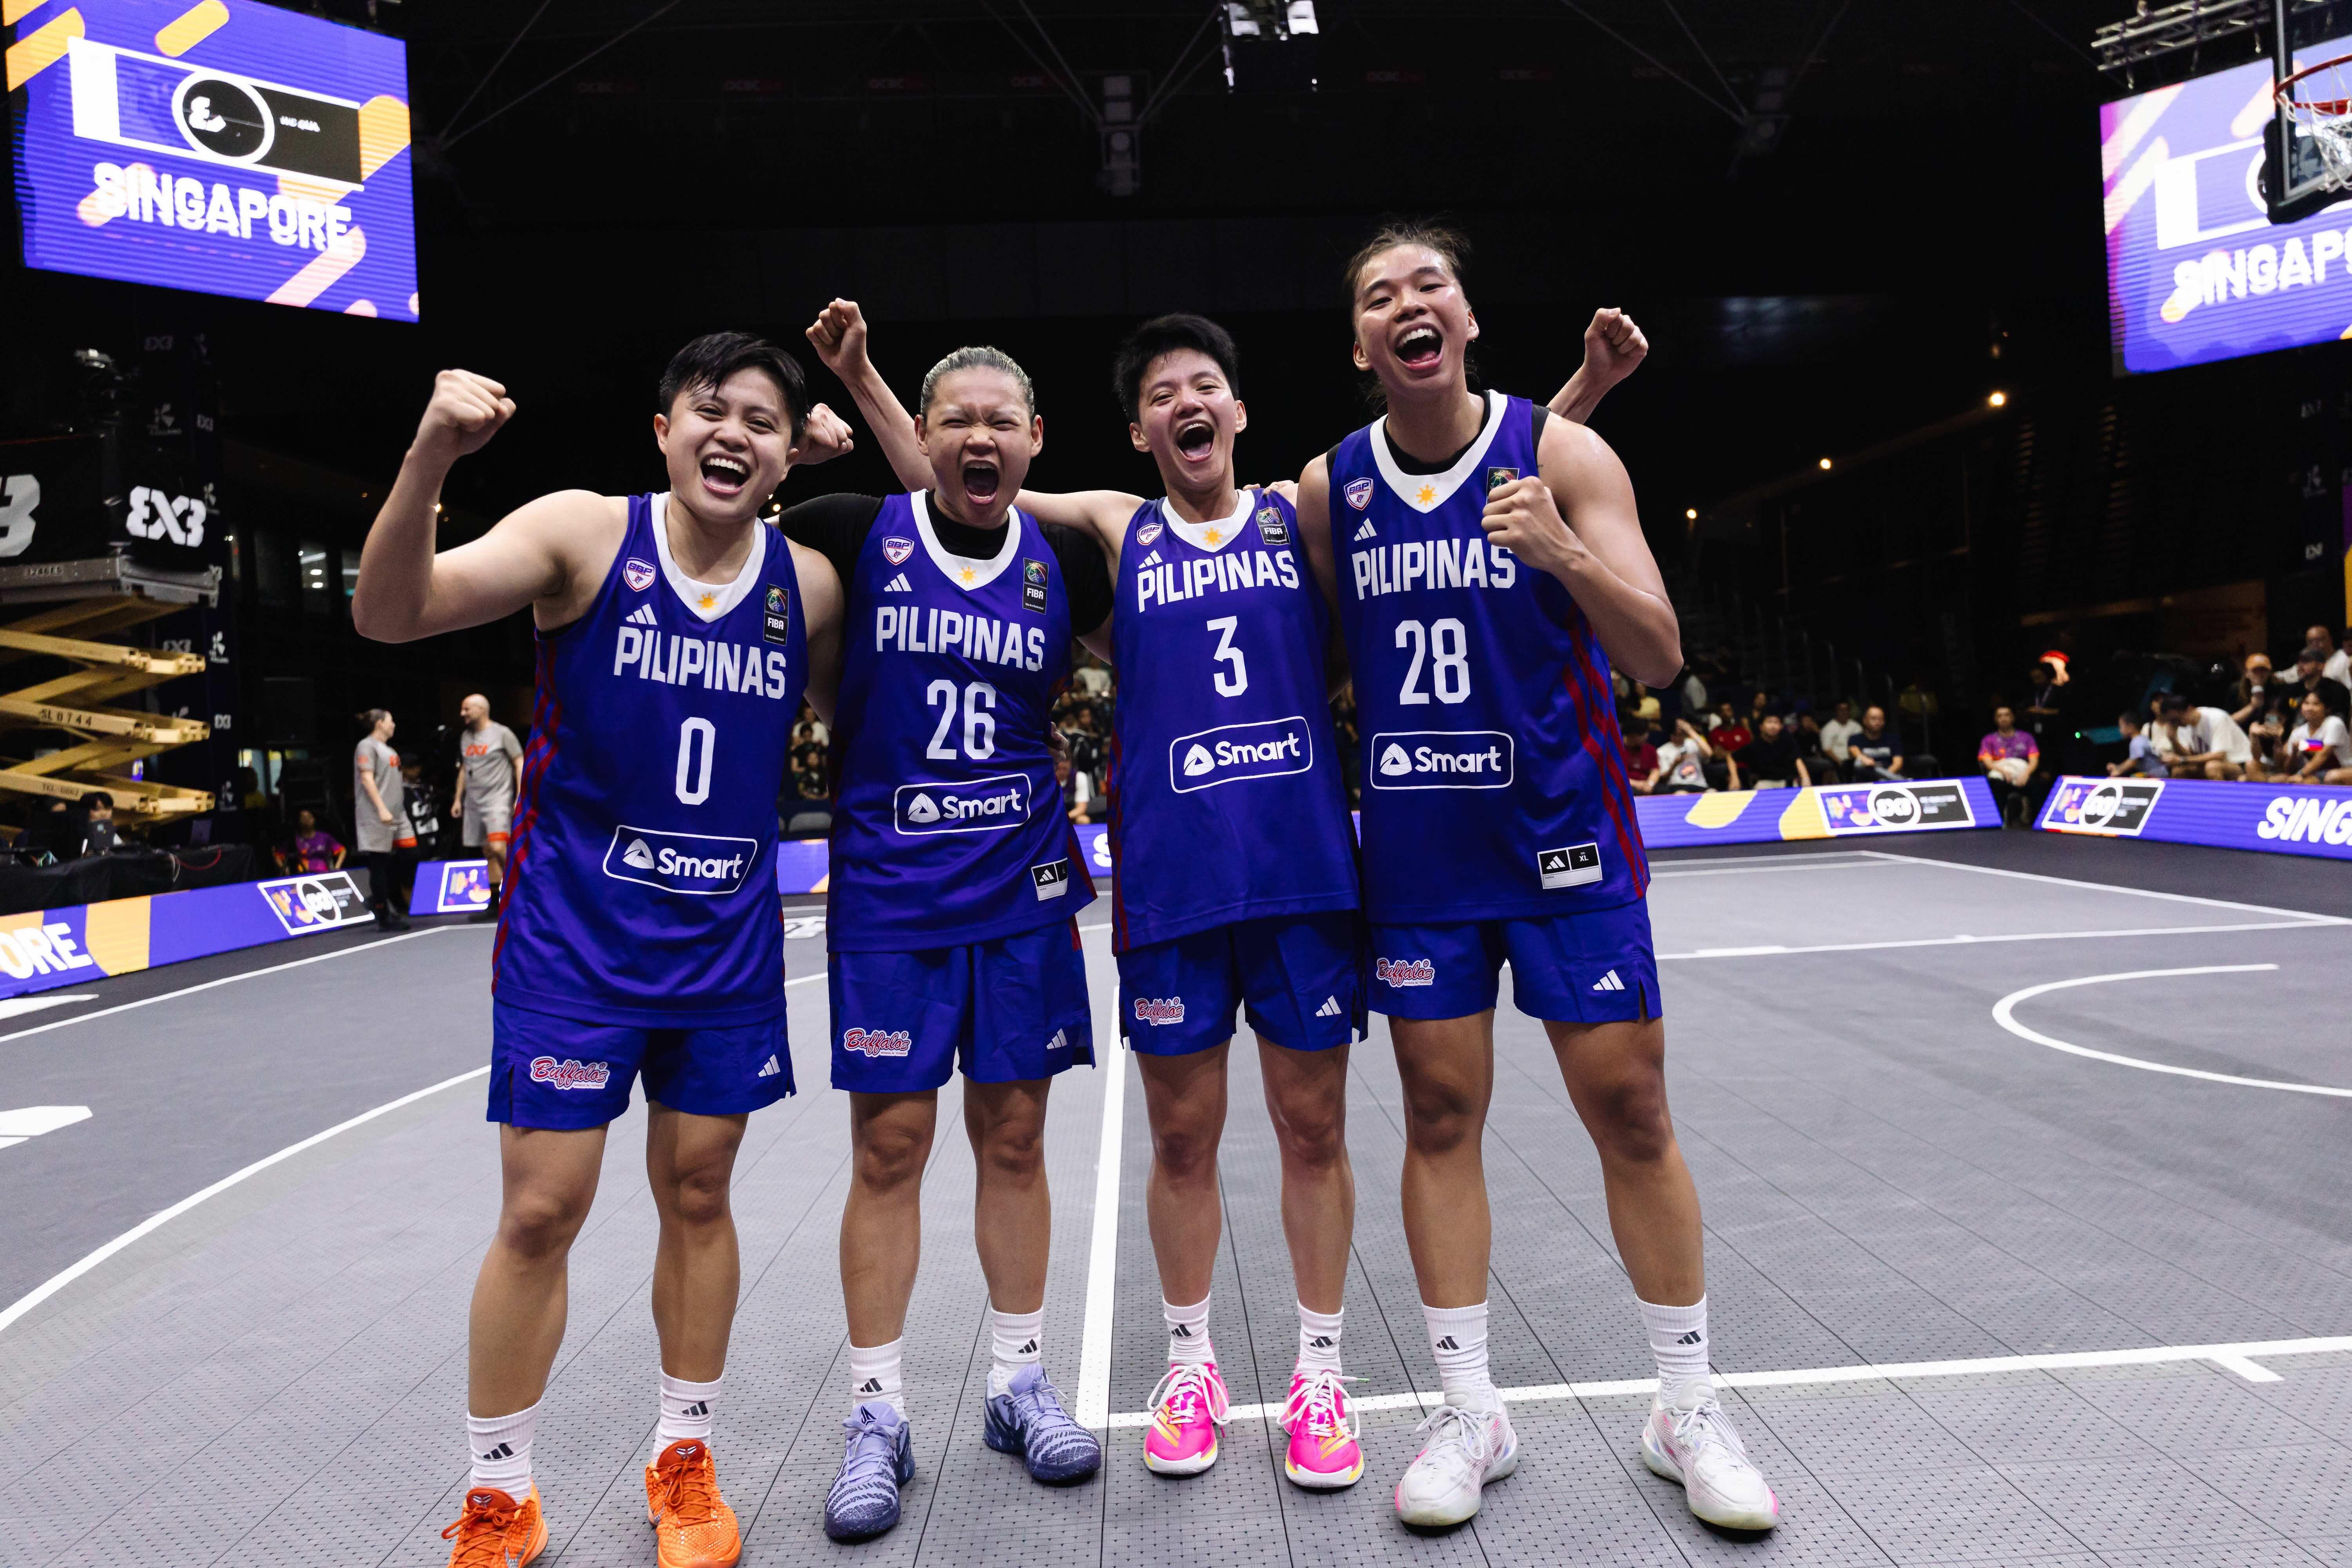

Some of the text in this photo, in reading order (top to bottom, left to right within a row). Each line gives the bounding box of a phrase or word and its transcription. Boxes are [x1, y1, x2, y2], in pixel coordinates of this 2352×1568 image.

[94, 162, 352, 257] SINGAPORE
[2174, 225, 2352, 307] SINGAP
[1349, 482, 1369, 494] SBP
[887, 541, 910, 549] SBP
[628, 562, 653, 574] SBP
[1138, 550, 1299, 613] PILIPINAS
[1352, 538, 1515, 600] PILIPINAS
[1027, 588, 1044, 600] FIBA
[768, 617, 784, 630] FIBA
[877, 606, 1045, 671] PILIPINAS
[614, 626, 786, 699] PILIPINAS
[1207, 615, 1248, 698] 3
[1395, 618, 1470, 705] 28
[926, 679, 996, 760] 26
[675, 717, 716, 805] 0
[1215, 732, 1300, 766] Smart
[1415, 746, 1501, 773] Smart
[942, 788, 1022, 819] Smart
[2257, 797, 2352, 846] SING
[657, 848, 743, 879] Smart
[846, 1029, 910, 1056] Buffalo's
[533, 1058, 608, 1088] Buffalo's
